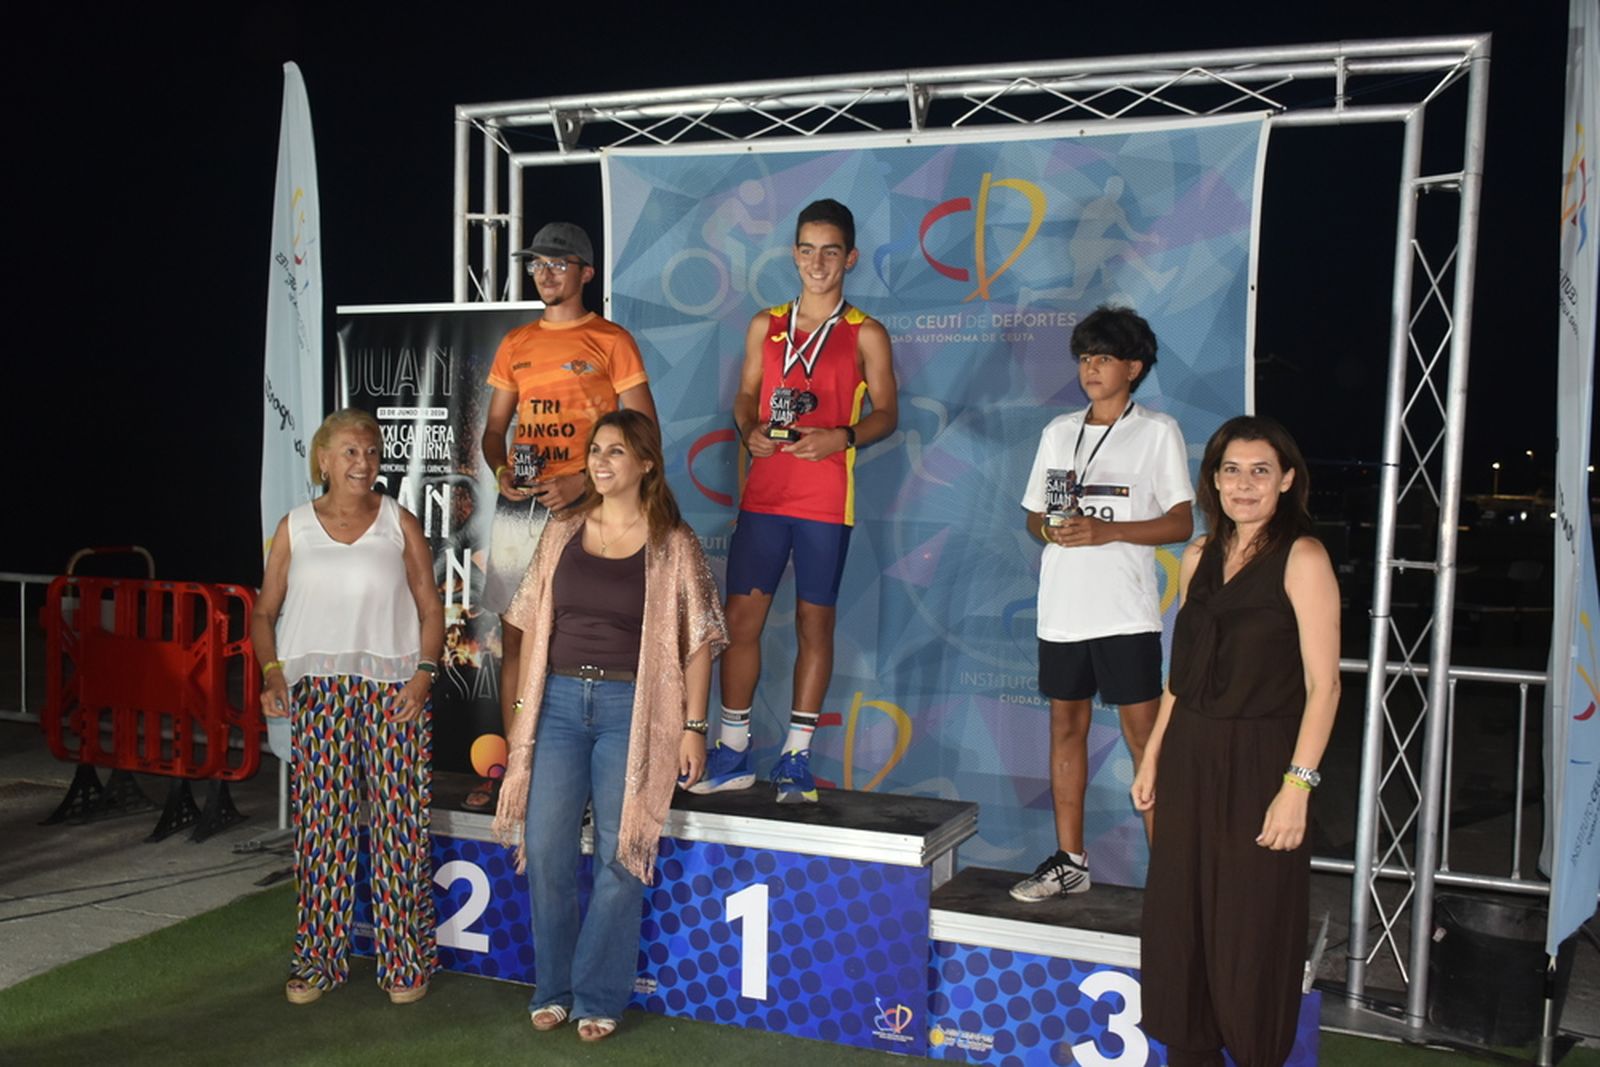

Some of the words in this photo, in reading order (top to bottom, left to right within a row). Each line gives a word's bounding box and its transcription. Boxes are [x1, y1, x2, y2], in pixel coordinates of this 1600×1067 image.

[915, 312, 962, 329] CEUTÍ
[967, 314, 987, 328] DE
[992, 312, 1077, 328] DEPORTES
[982, 333, 996, 343] DE
[349, 347, 453, 396] JUAN
[530, 399, 560, 414] TRI
[400, 425, 455, 443] CARERA
[519, 423, 575, 438] DINGO
[383, 441, 451, 460] NOCURNA
[541, 446, 569, 461] AM
[433, 860, 491, 953] 2
[725, 883, 769, 1001] 1
[1071, 971, 1149, 1067] 3
